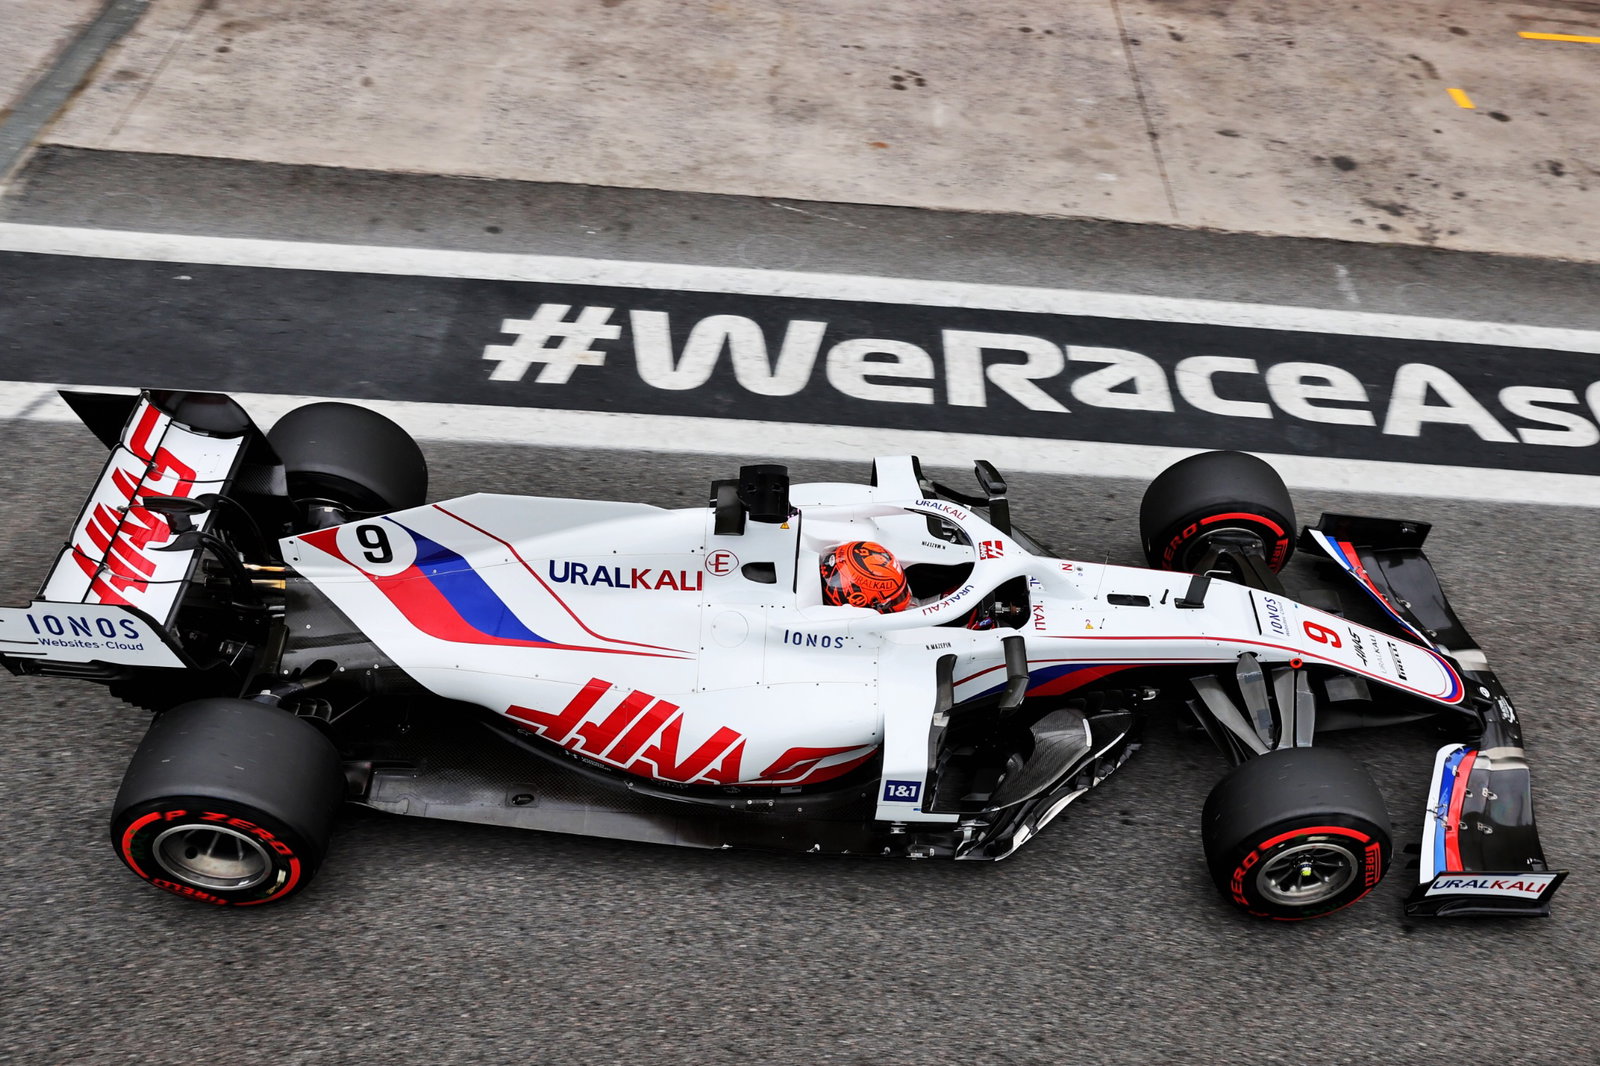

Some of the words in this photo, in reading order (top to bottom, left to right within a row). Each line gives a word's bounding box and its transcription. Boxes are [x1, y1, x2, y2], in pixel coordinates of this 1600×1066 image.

[915, 500, 967, 521] URALKALI
[356, 524, 393, 563] 9
[550, 559, 703, 591] URALKALI
[922, 584, 975, 616] URALKALI
[27, 614, 140, 640] IONOS
[1264, 597, 1284, 635] IONOS
[784, 629, 844, 649] IONOS
[1302, 620, 1342, 648] 9
[887, 784, 917, 798] 1&1
[200, 811, 294, 856] ZERO
[1432, 878, 1548, 895] URALKALI
